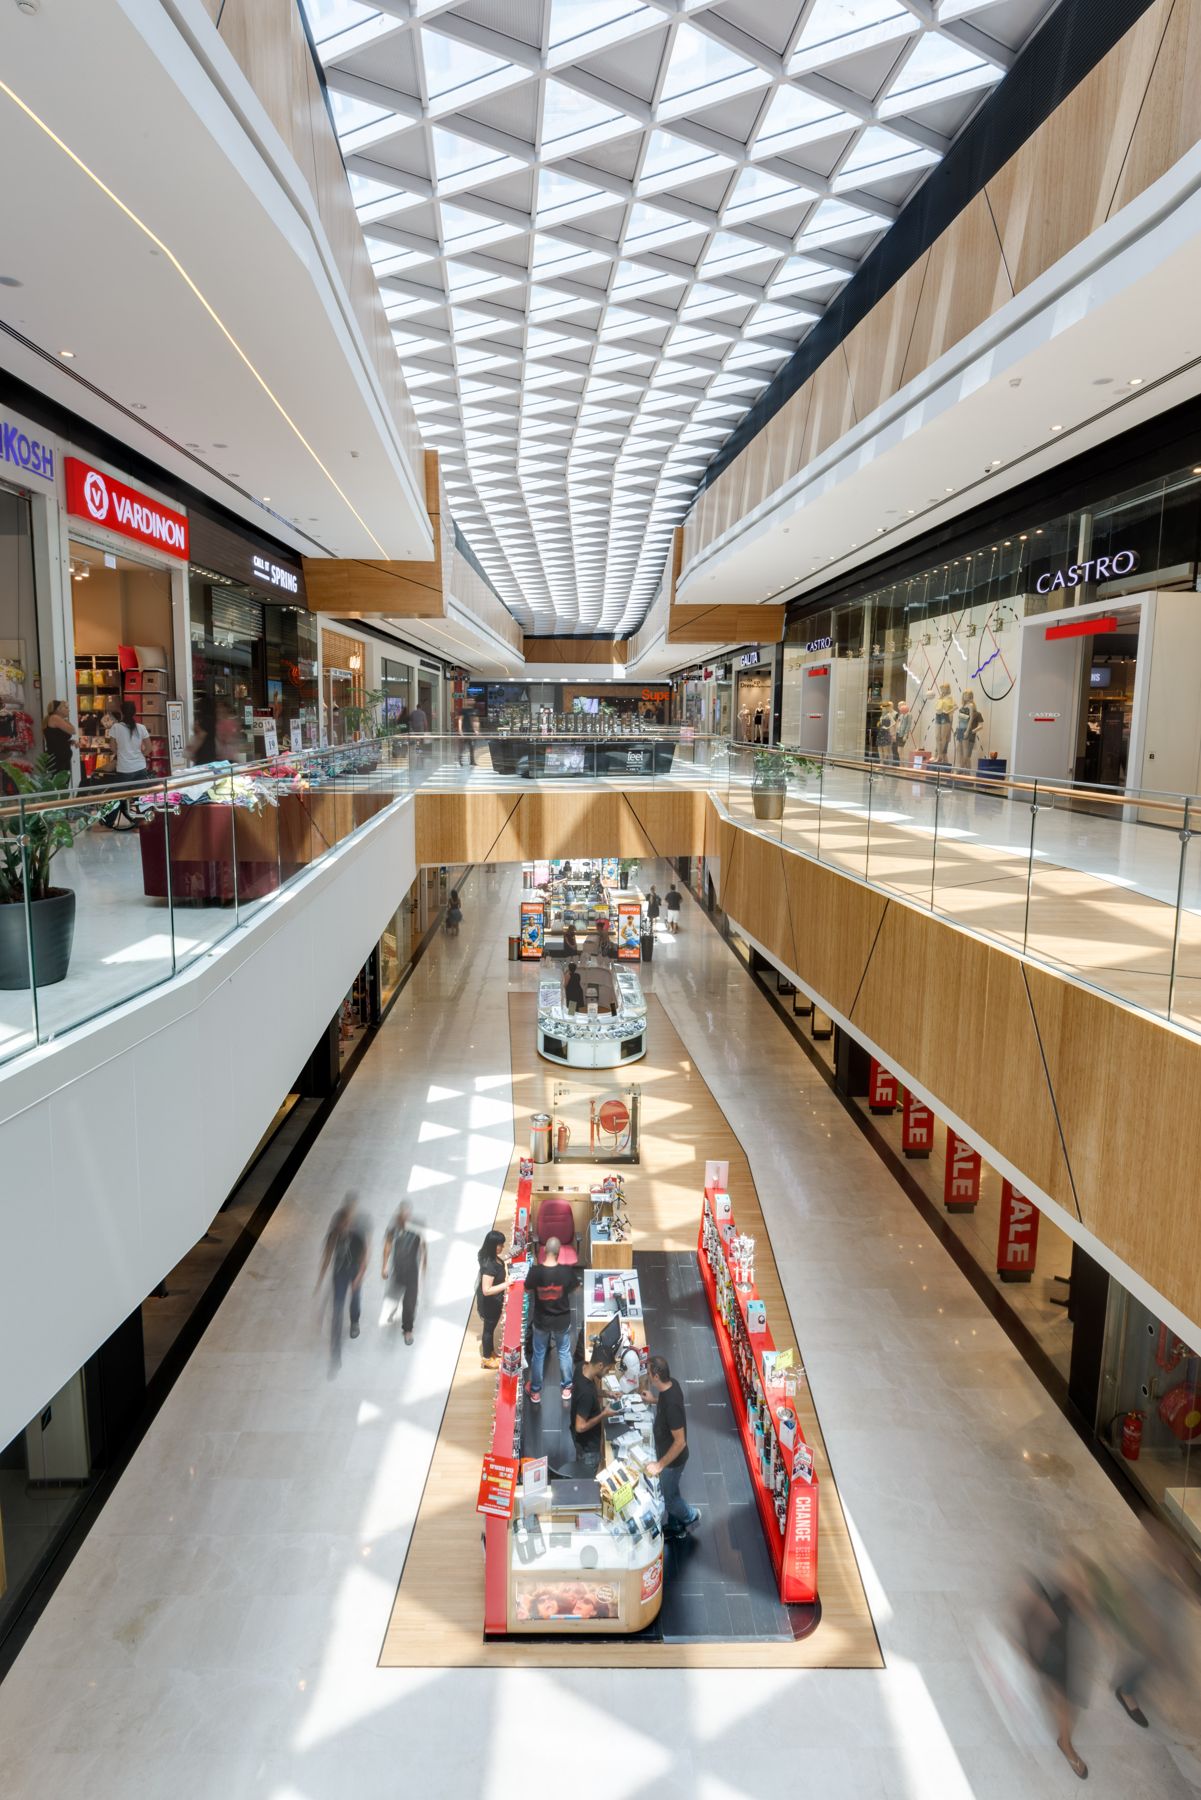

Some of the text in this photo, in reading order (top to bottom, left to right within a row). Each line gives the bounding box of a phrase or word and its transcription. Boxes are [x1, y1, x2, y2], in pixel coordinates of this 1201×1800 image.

[0, 422, 54, 477] KOSH
[112, 491, 185, 551] VARDINON
[270, 564, 298, 593] SPRING
[1036, 551, 1134, 594] CASTRO
[805, 636, 831, 653] CASTRO
[627, 752, 644, 761] feel
[909, 1092, 928, 1144] ALE
[952, 1133, 975, 1196] ALE
[795, 1496, 812, 1542] CHANGE
